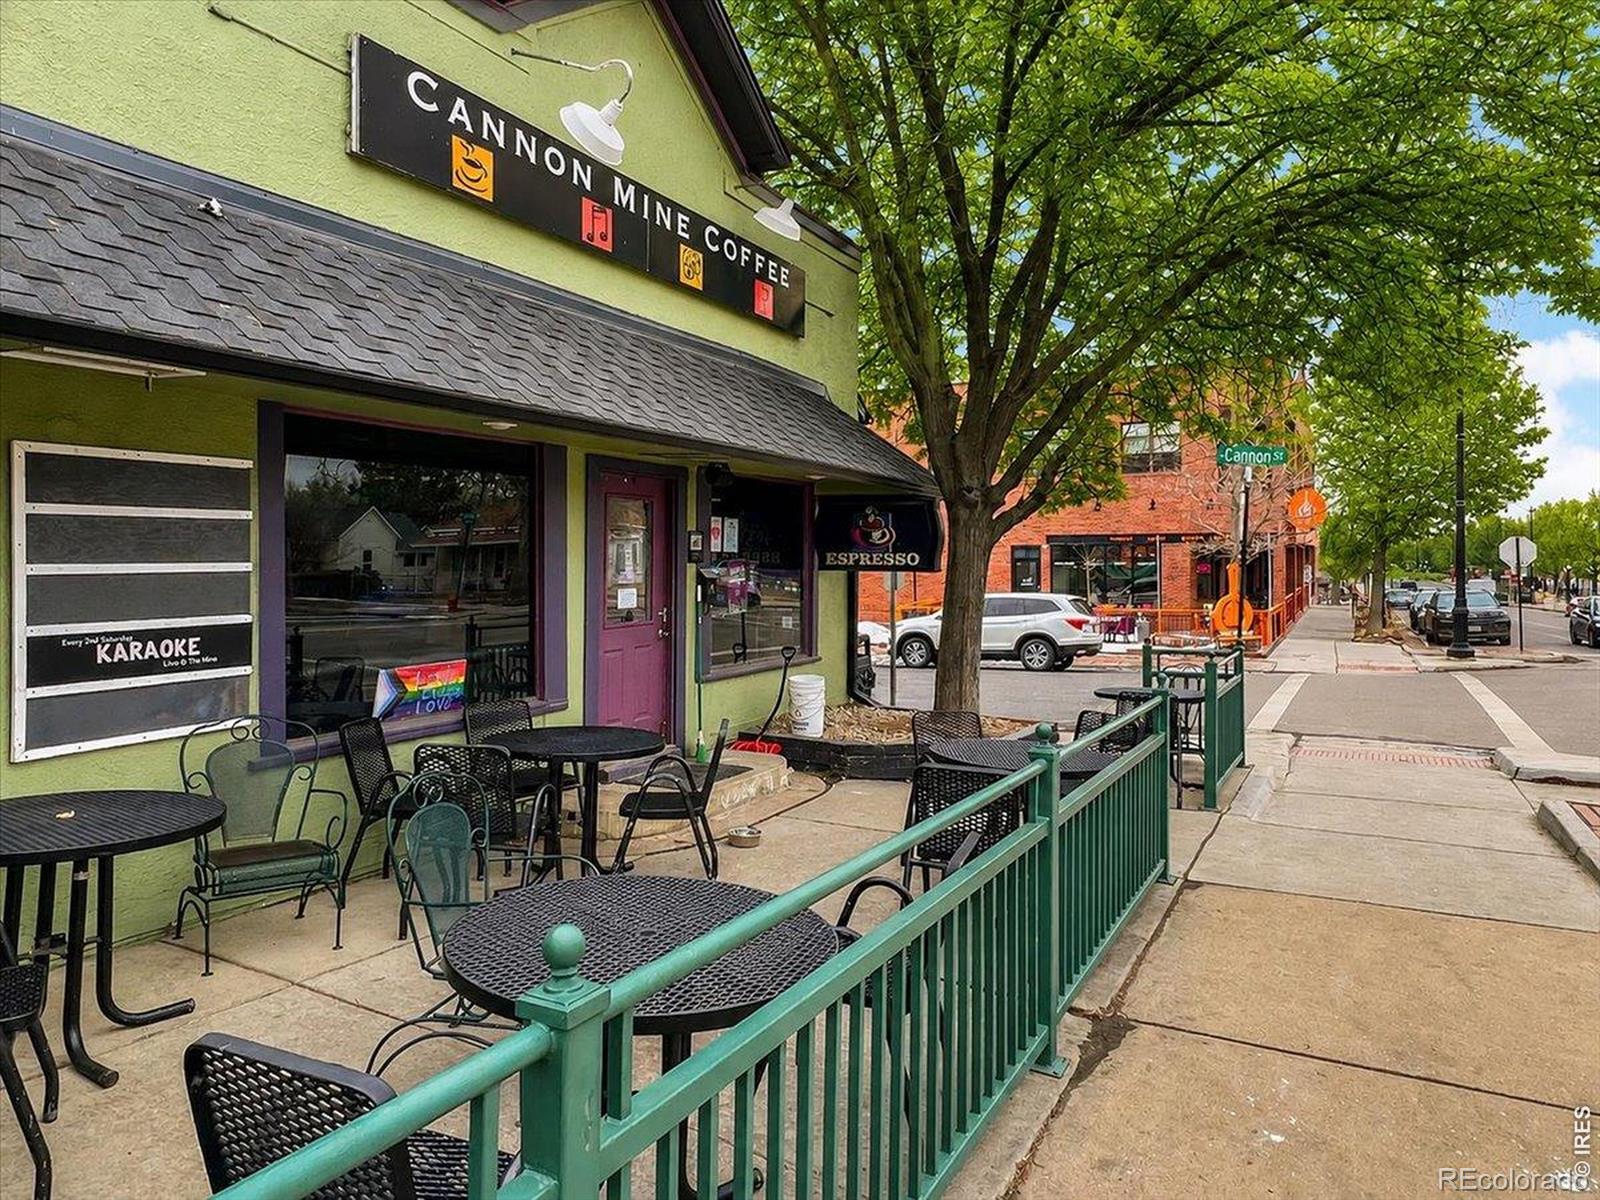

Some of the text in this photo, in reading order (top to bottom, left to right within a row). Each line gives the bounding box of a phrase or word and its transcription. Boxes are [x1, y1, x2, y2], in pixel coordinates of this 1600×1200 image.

[407, 71, 790, 288] CANNON MINE COFFEE
[1225, 448, 1271, 464] Cannon
[825, 552, 920, 566] ESPRESSO
[96, 637, 201, 664] KARAOKE
